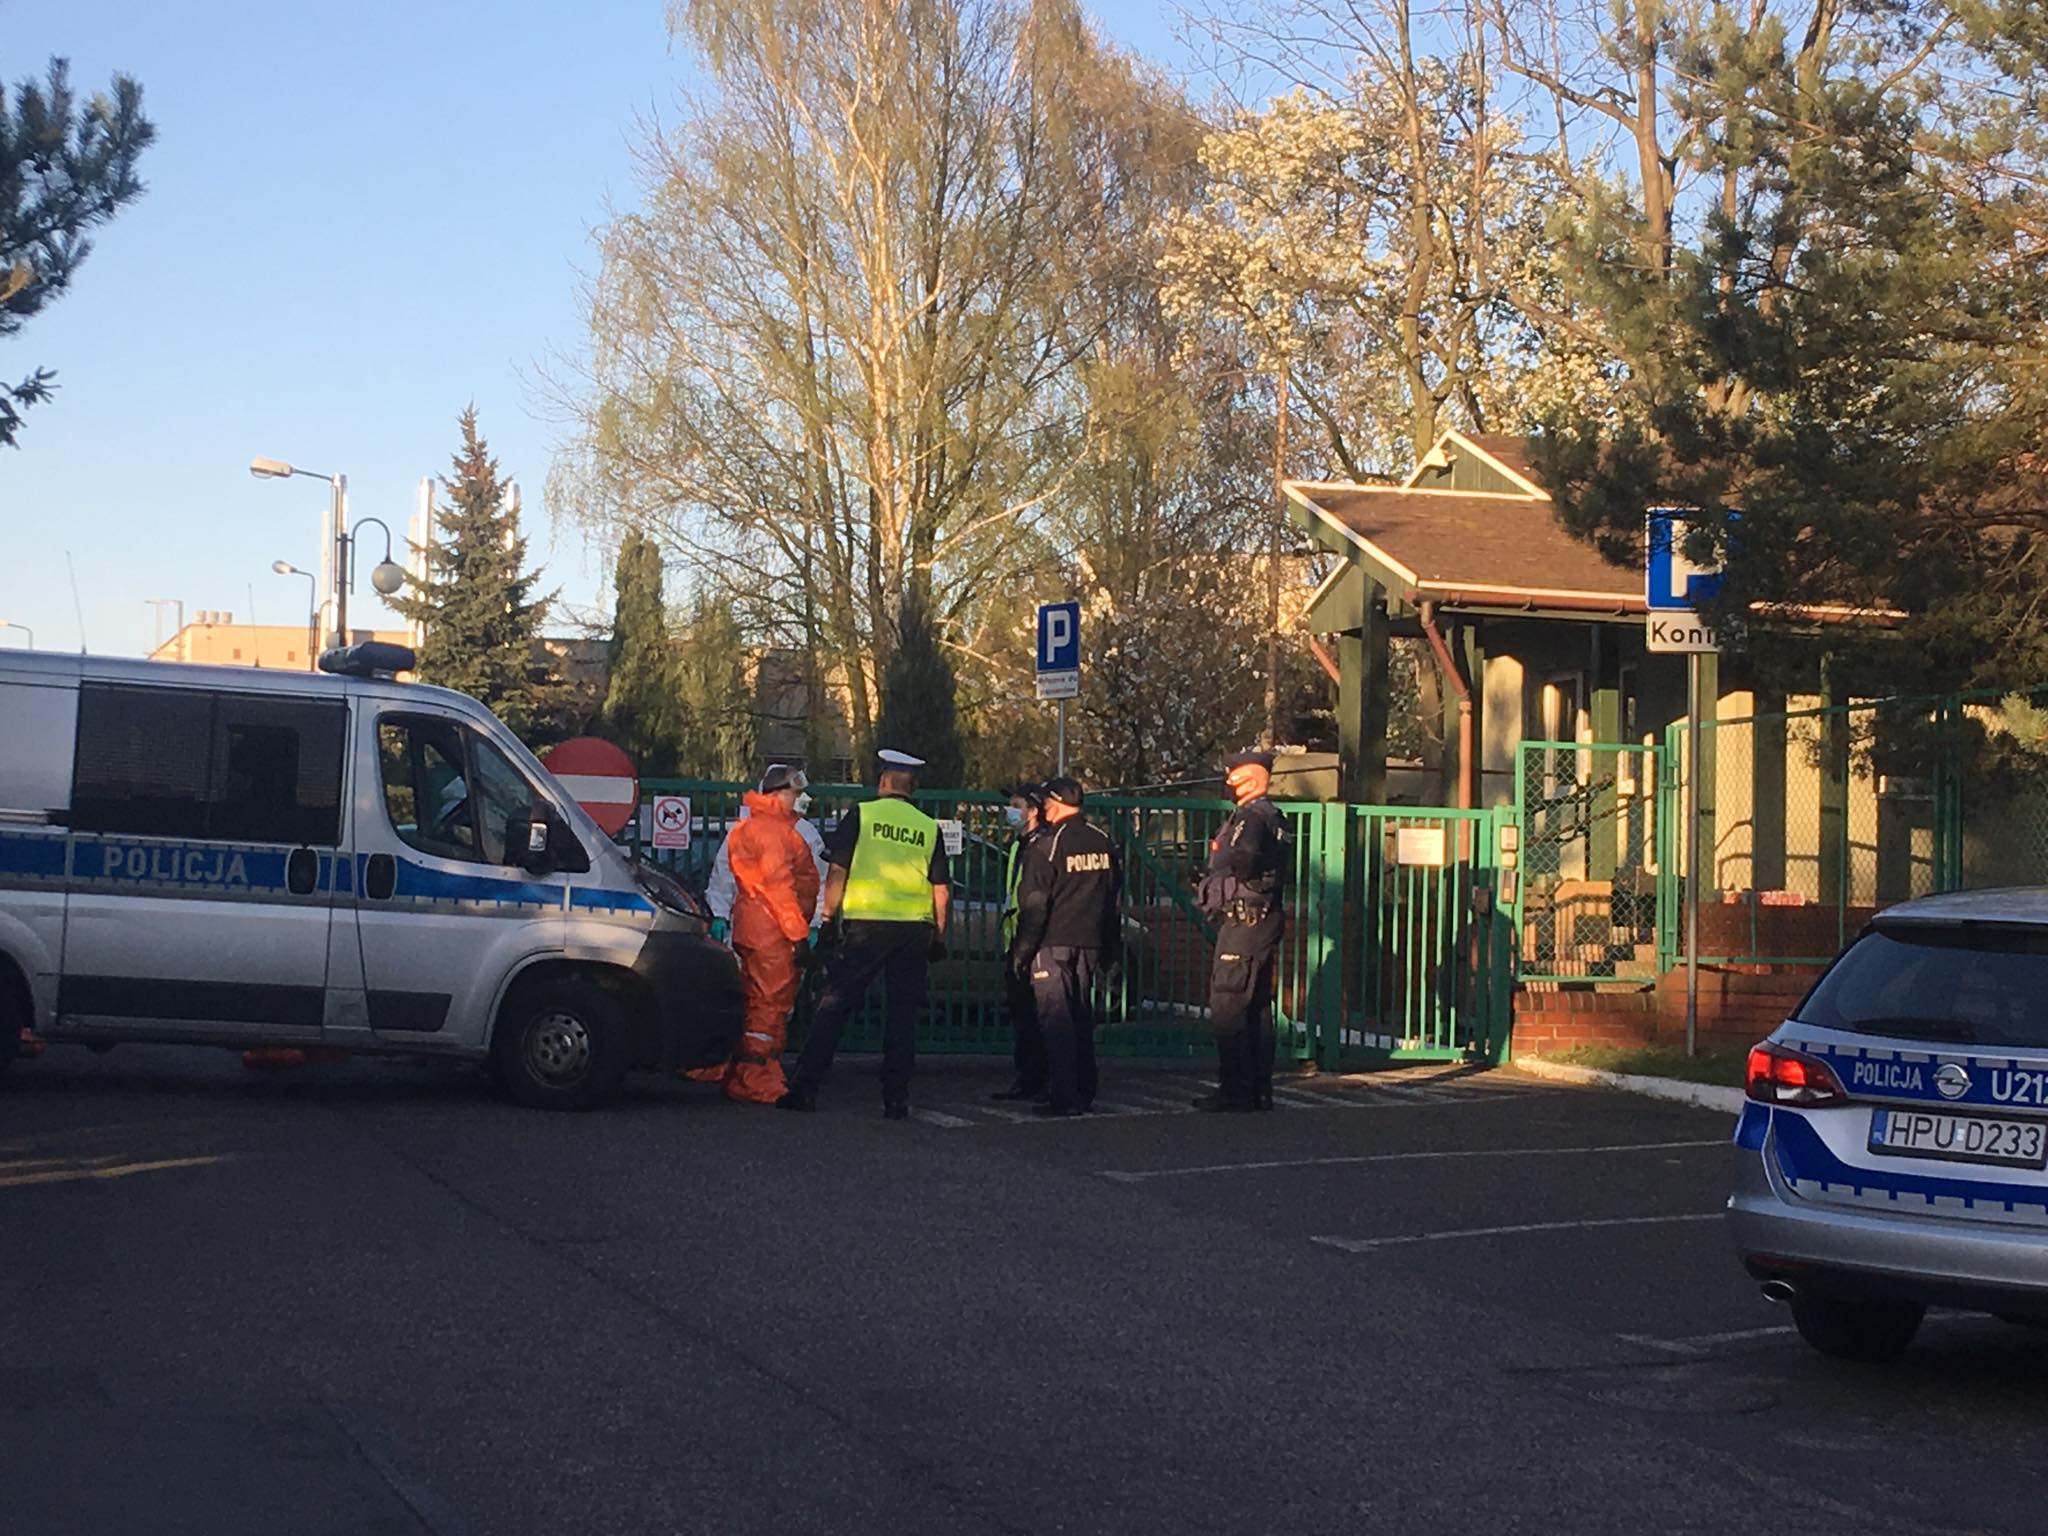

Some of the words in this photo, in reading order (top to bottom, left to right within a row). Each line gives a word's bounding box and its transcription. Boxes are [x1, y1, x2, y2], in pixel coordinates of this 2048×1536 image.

[1046, 609, 1071, 663] P
[1651, 620, 1715, 644] Koni
[873, 822, 926, 847] POLICJA
[103, 846, 249, 883] POLICJA
[1066, 853, 1111, 873] POLICJA
[1853, 1062, 1924, 1090] POLICJA
[1890, 1114, 1957, 1148] HPU
[1965, 1121, 2041, 1157] D233
